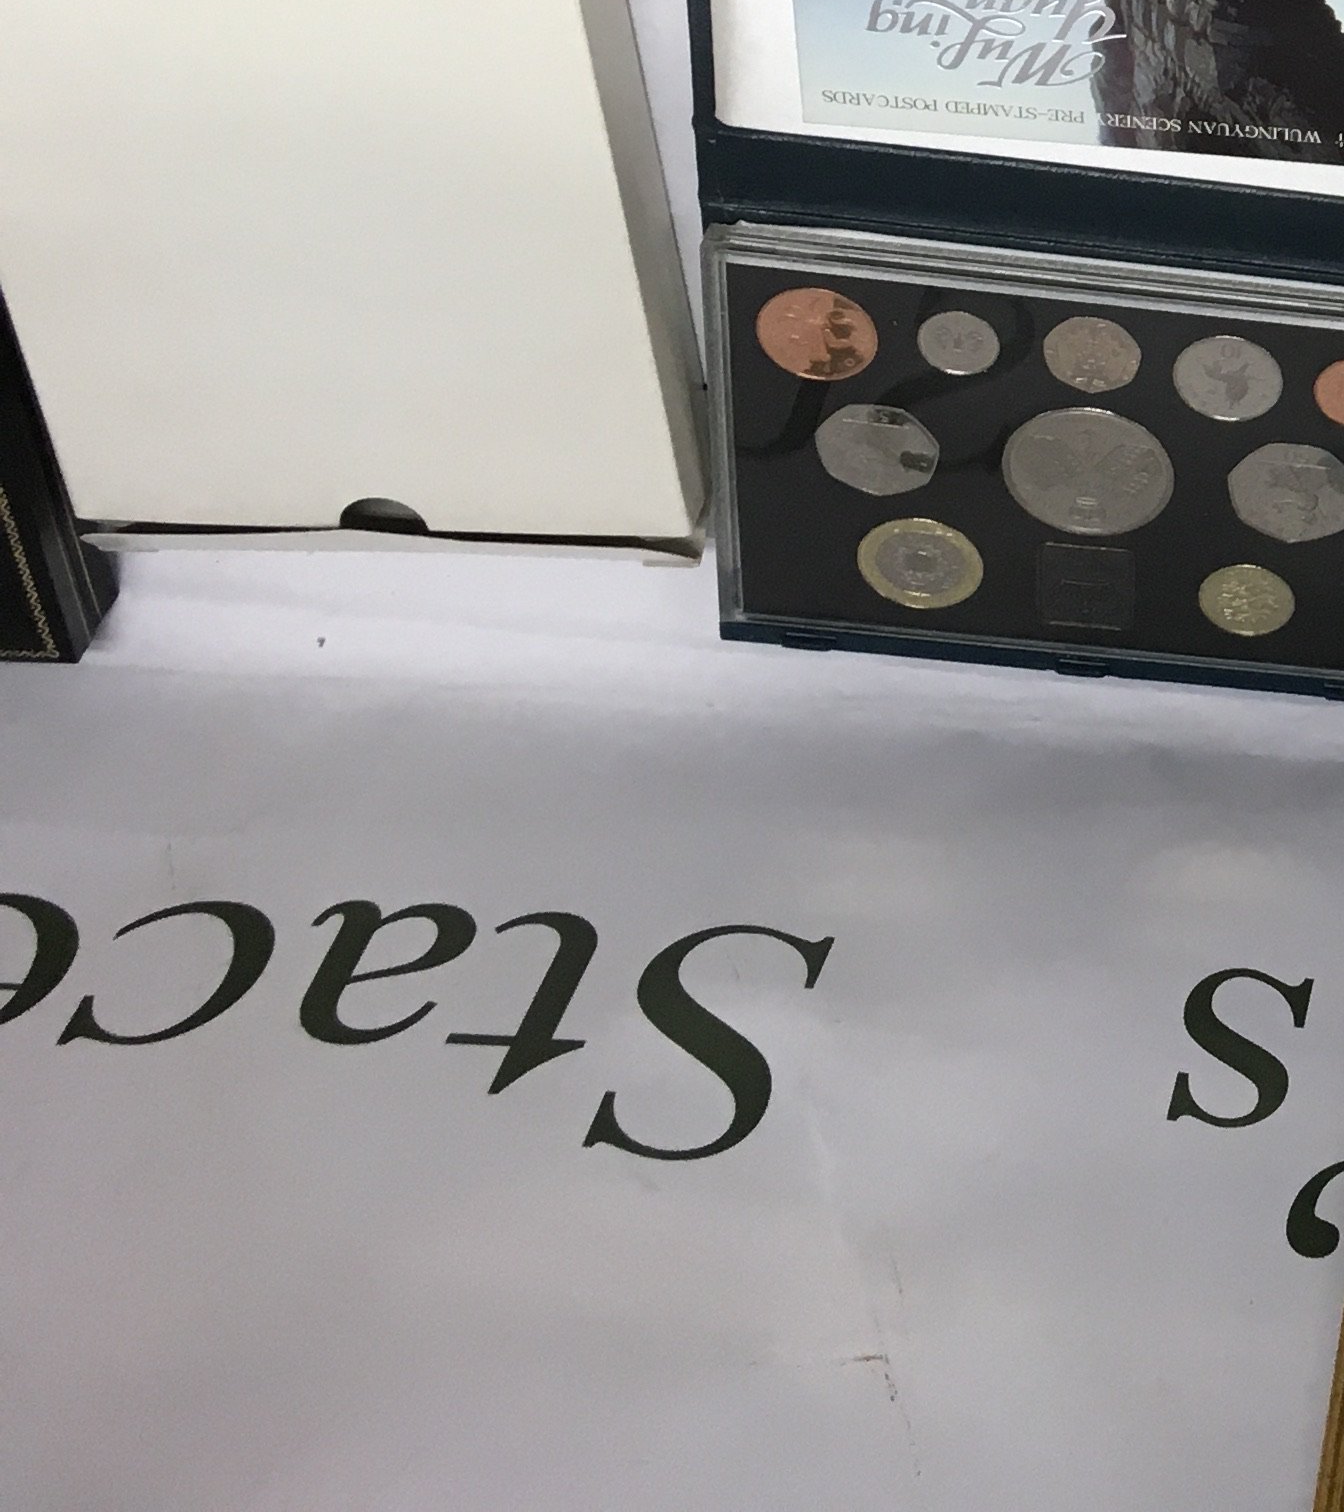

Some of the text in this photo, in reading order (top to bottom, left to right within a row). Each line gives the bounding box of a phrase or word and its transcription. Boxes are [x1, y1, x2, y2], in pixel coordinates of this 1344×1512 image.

[821, 89, 1085, 124] PRE-STAMPED POSTCARDS
[1095, 113, 1322, 145] WULINGYUAN SCENERY
